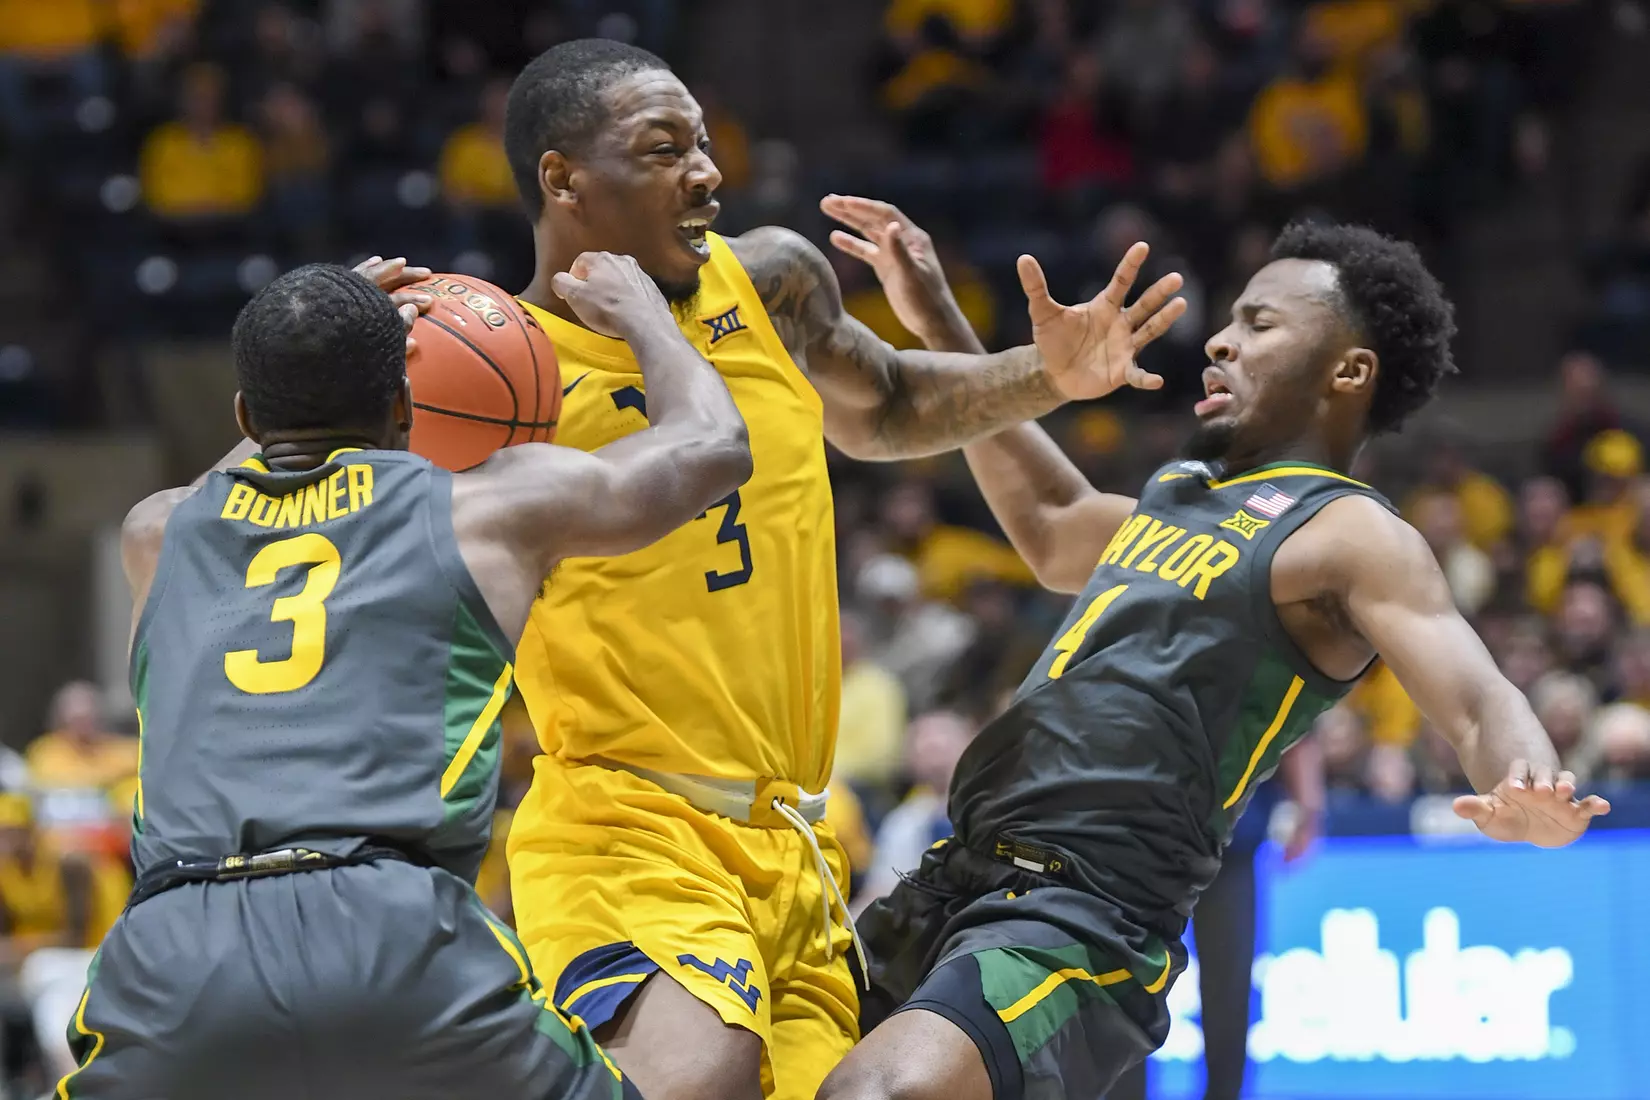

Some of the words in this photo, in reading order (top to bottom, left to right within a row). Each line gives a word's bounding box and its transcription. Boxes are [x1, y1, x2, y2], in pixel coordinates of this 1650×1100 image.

[702, 304, 748, 344] XII
[220, 464, 374, 529] BONNER
[1224, 512, 1263, 538] XII
[693, 488, 754, 593] 3
[1097, 513, 1240, 600] AYLOR
[224, 532, 342, 695] 3
[1047, 584, 1130, 680] 4
